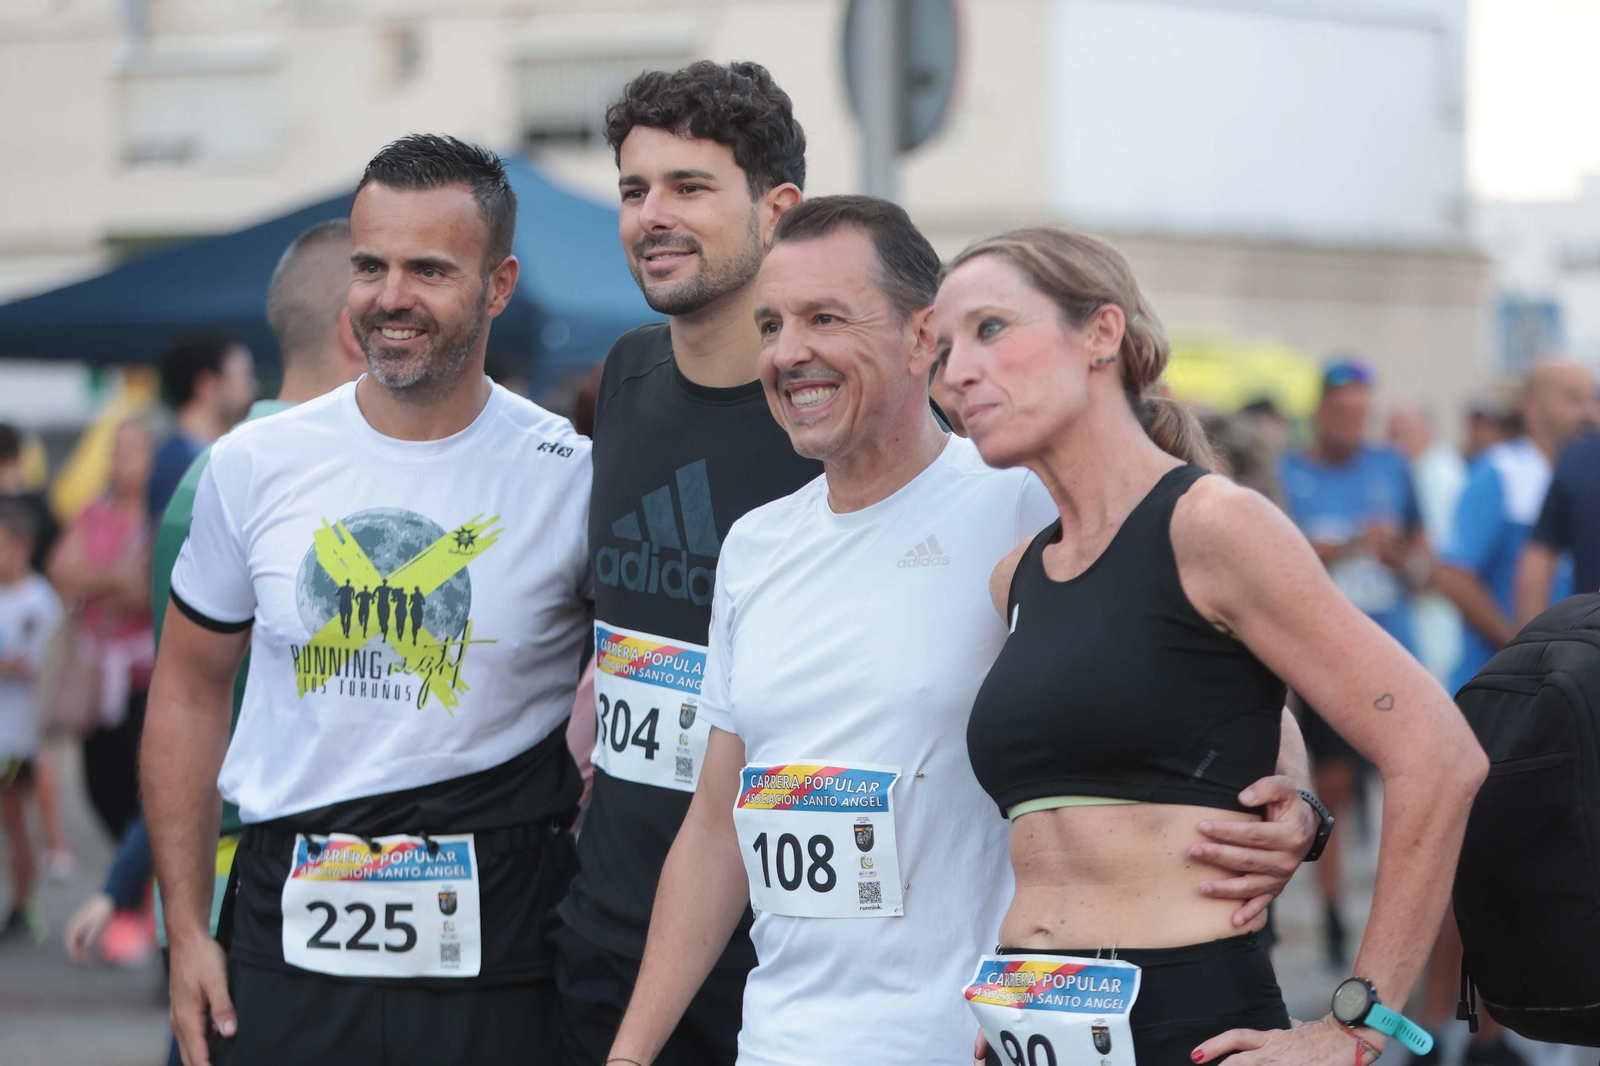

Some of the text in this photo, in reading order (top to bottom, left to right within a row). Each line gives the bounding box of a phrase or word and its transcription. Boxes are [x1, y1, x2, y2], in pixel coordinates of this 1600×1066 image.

[595, 541, 716, 606] adida
[896, 555, 950, 569] adidas
[290, 643, 382, 680] RUNNING
[643, 650, 706, 675] POPULA
[304, 676, 327, 694] LOS
[638, 667, 674, 684] SANTO
[677, 677, 702, 690] ANG
[750, 774, 880, 794] CARRERA POPULAR
[744, 794, 883, 808] ASOCIACION SANTO ANGEL
[380, 850, 457, 866] POPULAR
[753, 832, 837, 893] 108
[377, 866, 421, 879] SANTO
[425, 865, 467, 878] ANGEL
[306, 900, 418, 953] 225
[987, 971, 1122, 994] CARRERA POPULAR
[972, 987, 1124, 1010] ASOCIACION SANTO ANGEL
